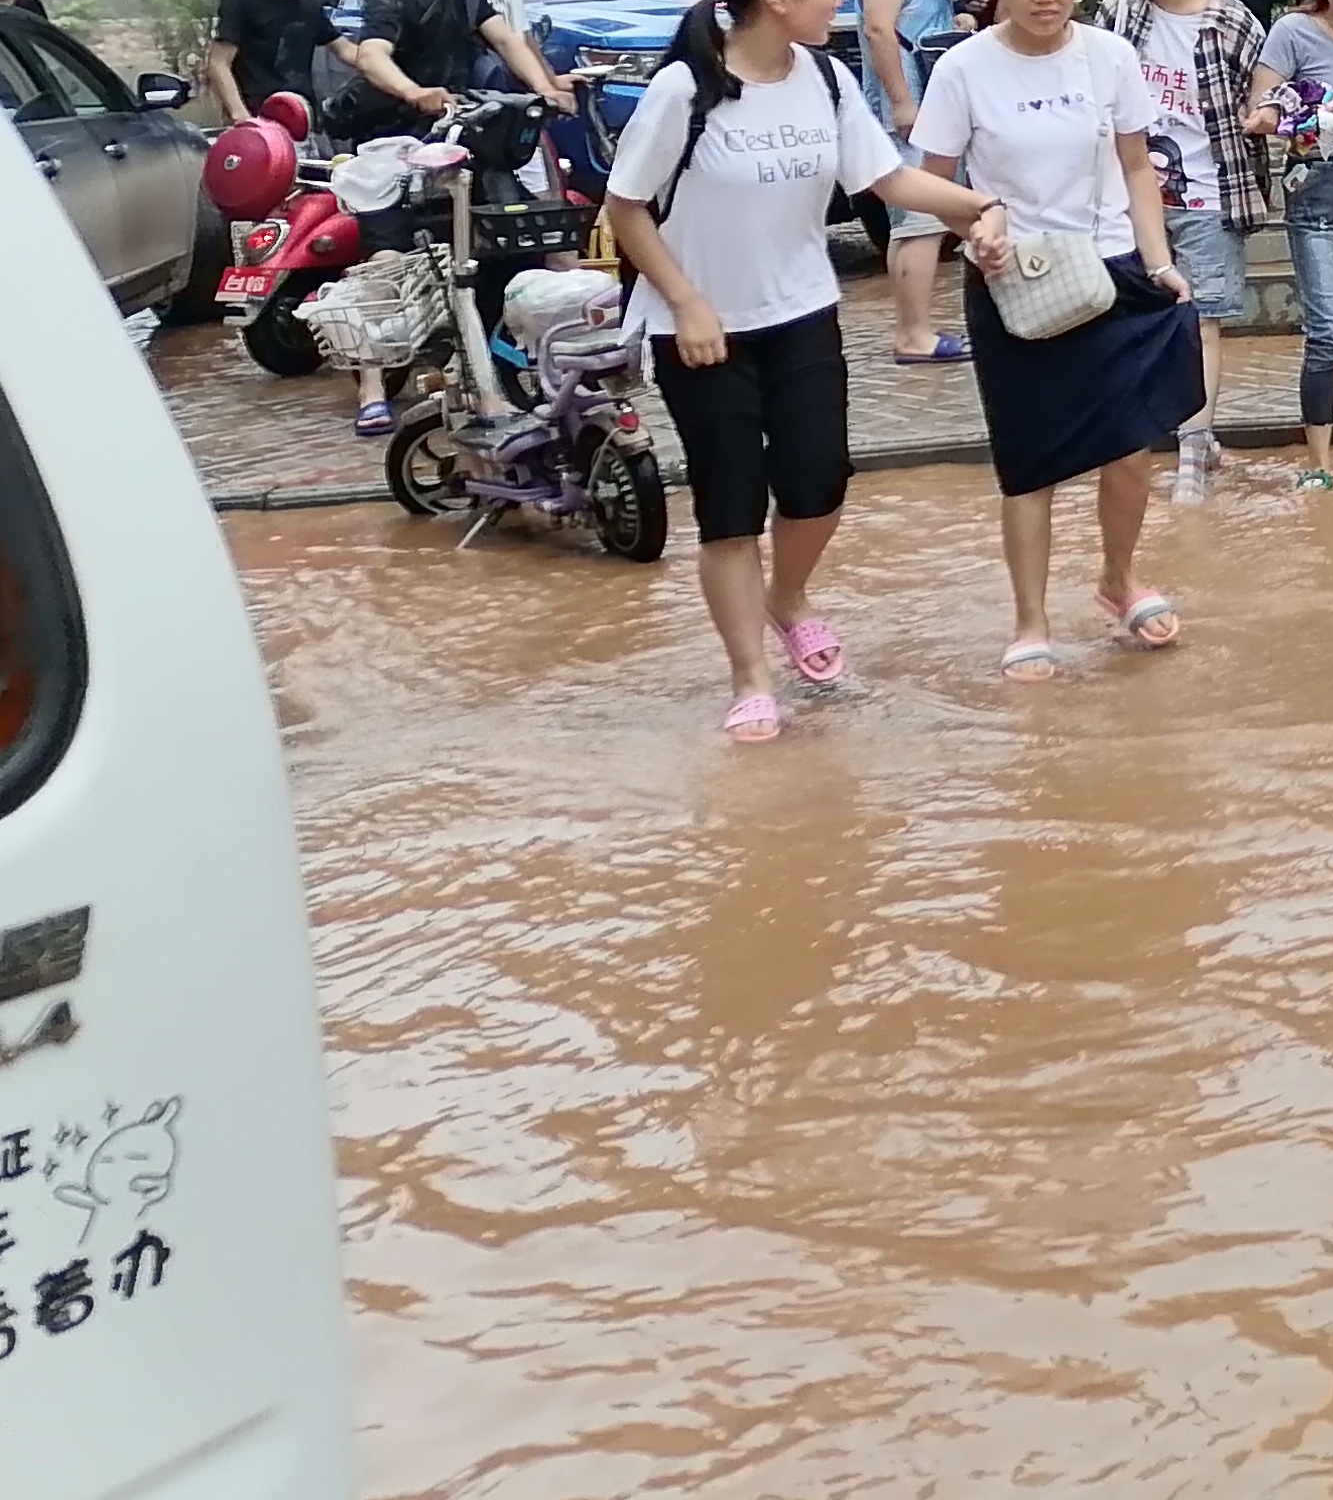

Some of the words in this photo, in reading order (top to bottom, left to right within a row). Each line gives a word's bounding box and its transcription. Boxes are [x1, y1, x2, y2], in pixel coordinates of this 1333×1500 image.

[779, 124, 831, 148] Beau
[757, 161, 775, 183] la
[777, 154, 821, 181] Vie!
